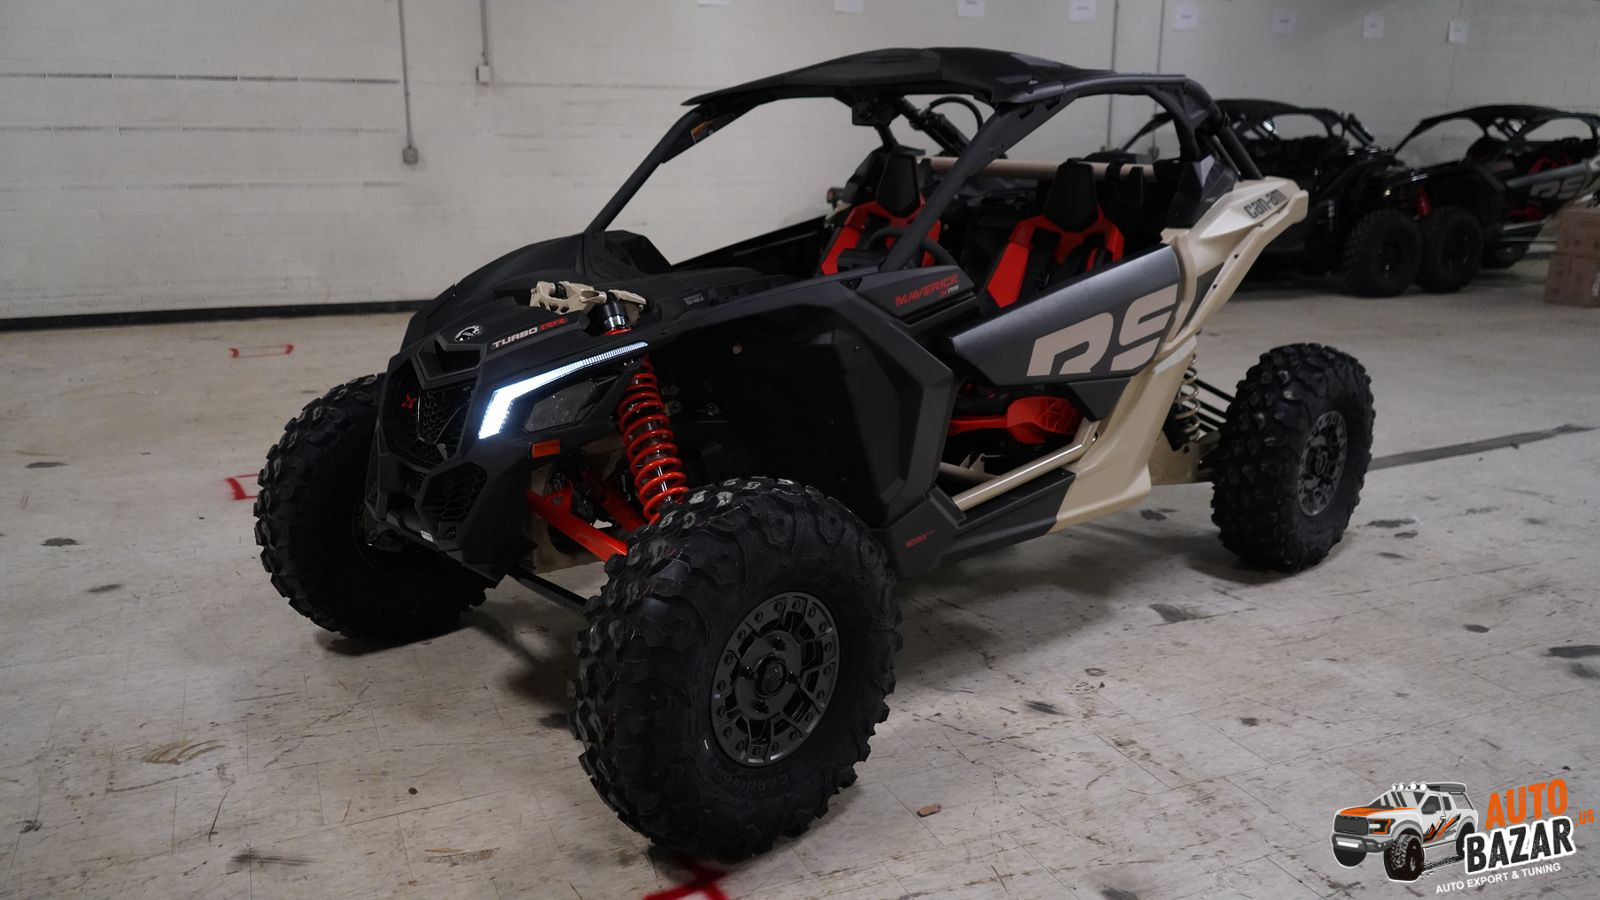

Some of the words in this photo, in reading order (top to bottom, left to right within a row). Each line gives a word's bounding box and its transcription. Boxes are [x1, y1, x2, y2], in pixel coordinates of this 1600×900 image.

[896, 274, 960, 306] MAVERICK
[492, 326, 538, 348] TURBO
[1026, 283, 1178, 376] RS
